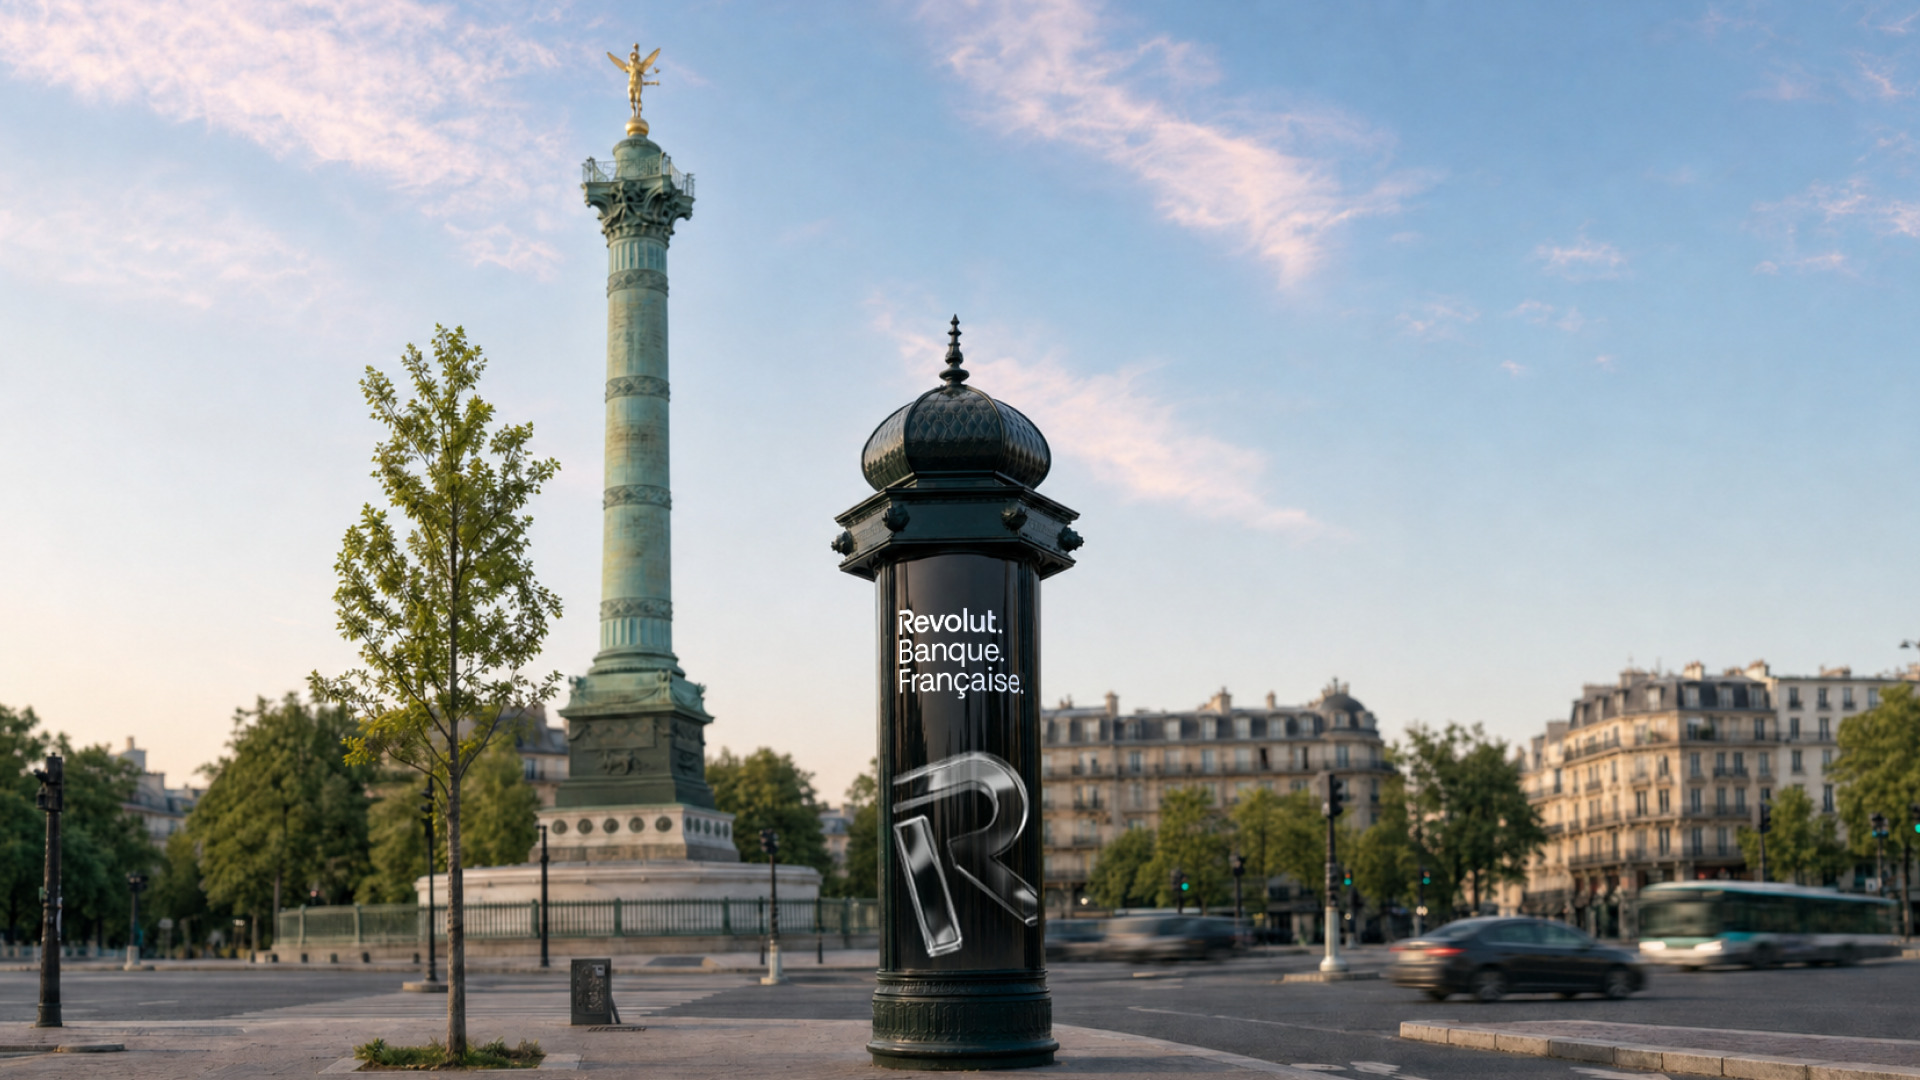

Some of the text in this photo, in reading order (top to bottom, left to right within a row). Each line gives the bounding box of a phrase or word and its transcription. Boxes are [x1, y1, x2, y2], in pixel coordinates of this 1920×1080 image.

[899, 608, 1003, 635] Revolut.
[899, 639, 1005, 668] Banque.
[899, 667, 1024, 699] Française.
[893, 751, 1038, 957] R
